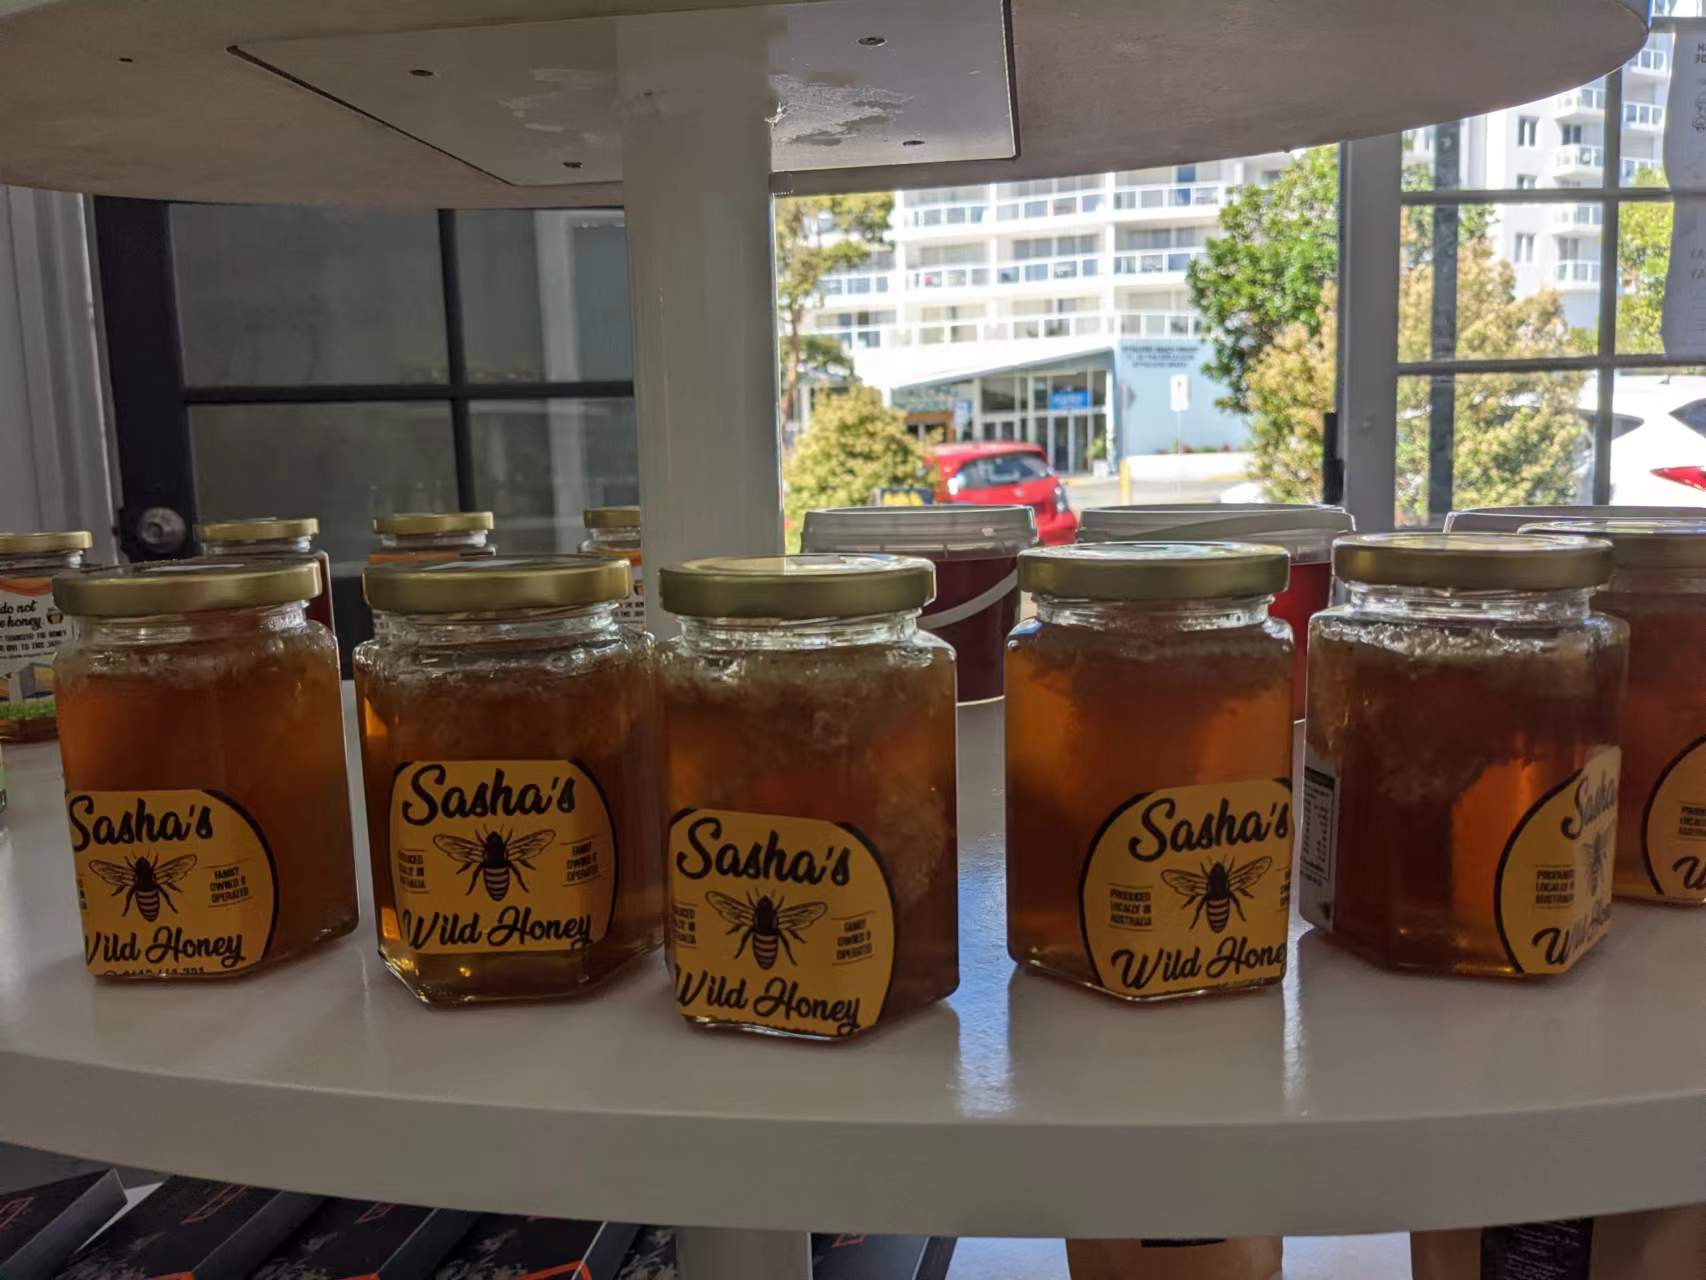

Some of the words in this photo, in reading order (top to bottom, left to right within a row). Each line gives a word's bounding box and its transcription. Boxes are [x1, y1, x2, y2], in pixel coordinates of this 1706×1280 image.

[16, 600, 37, 613] not
[402, 763, 576, 826] Sasha's
[68, 795, 214, 852] Sasha's
[676, 817, 851, 886] Sasha's
[1128, 797, 1290, 862] Sasha's
[145, 926, 246, 968] Honey
[403, 908, 482, 951] Wild
[487, 905, 593, 952] Honey
[1111, 948, 1202, 990] Wild
[1206, 936, 1287, 978] Hone
[753, 976, 861, 1034] Honey
